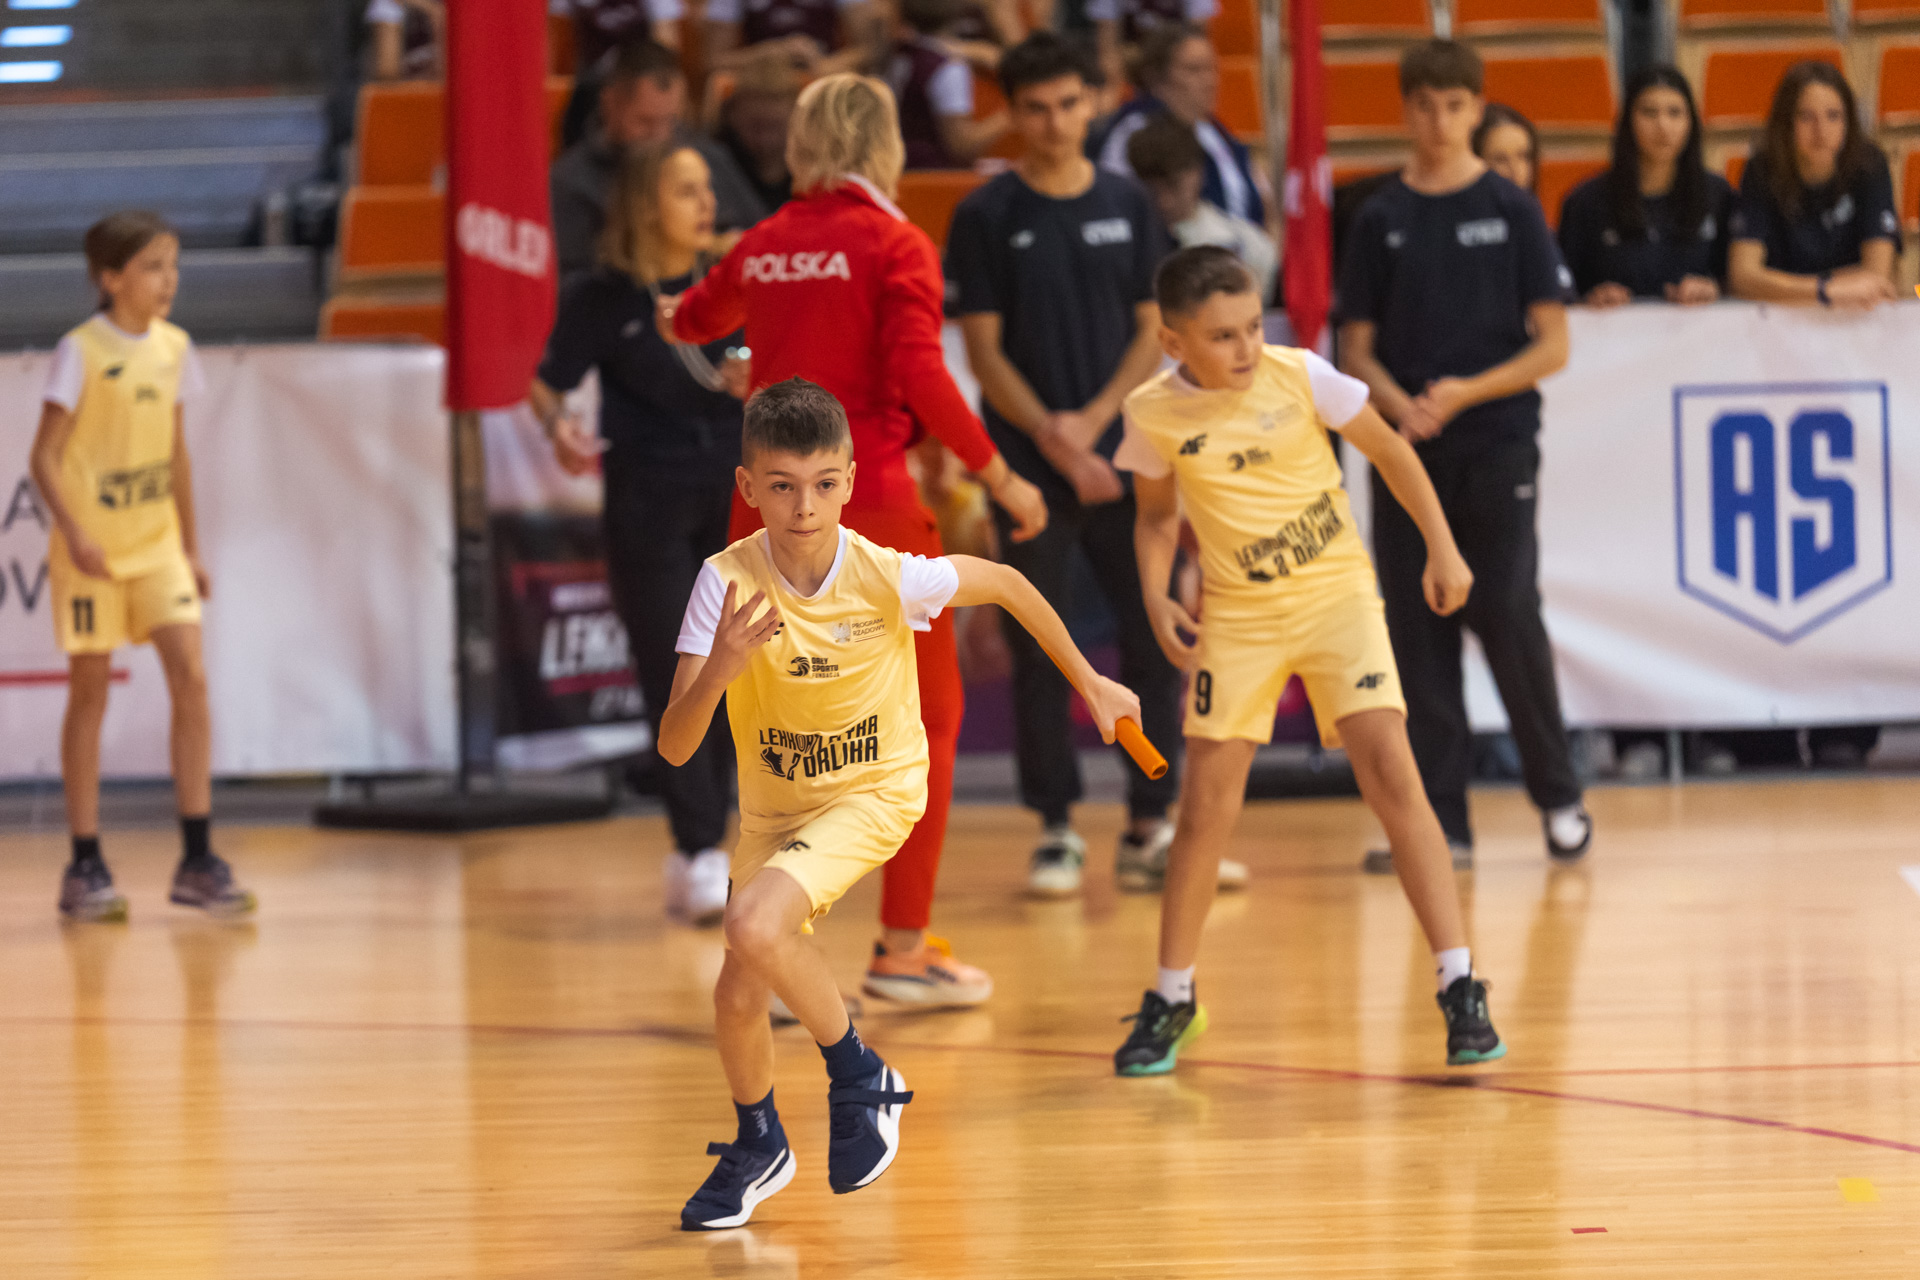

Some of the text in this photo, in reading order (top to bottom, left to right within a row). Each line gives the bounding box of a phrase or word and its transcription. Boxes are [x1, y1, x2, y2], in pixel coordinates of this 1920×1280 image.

[742, 251, 851, 283] POLSKA
[1710, 409, 1856, 604] AS
[72, 597, 94, 636] 11
[851, 617, 884, 629] PROGRAM
[852, 624, 886, 637] RZĄDOWY
[811, 664, 839, 673] SPORTU
[1196, 669, 1213, 716] 9
[803, 735, 879, 778] ORLIKA
